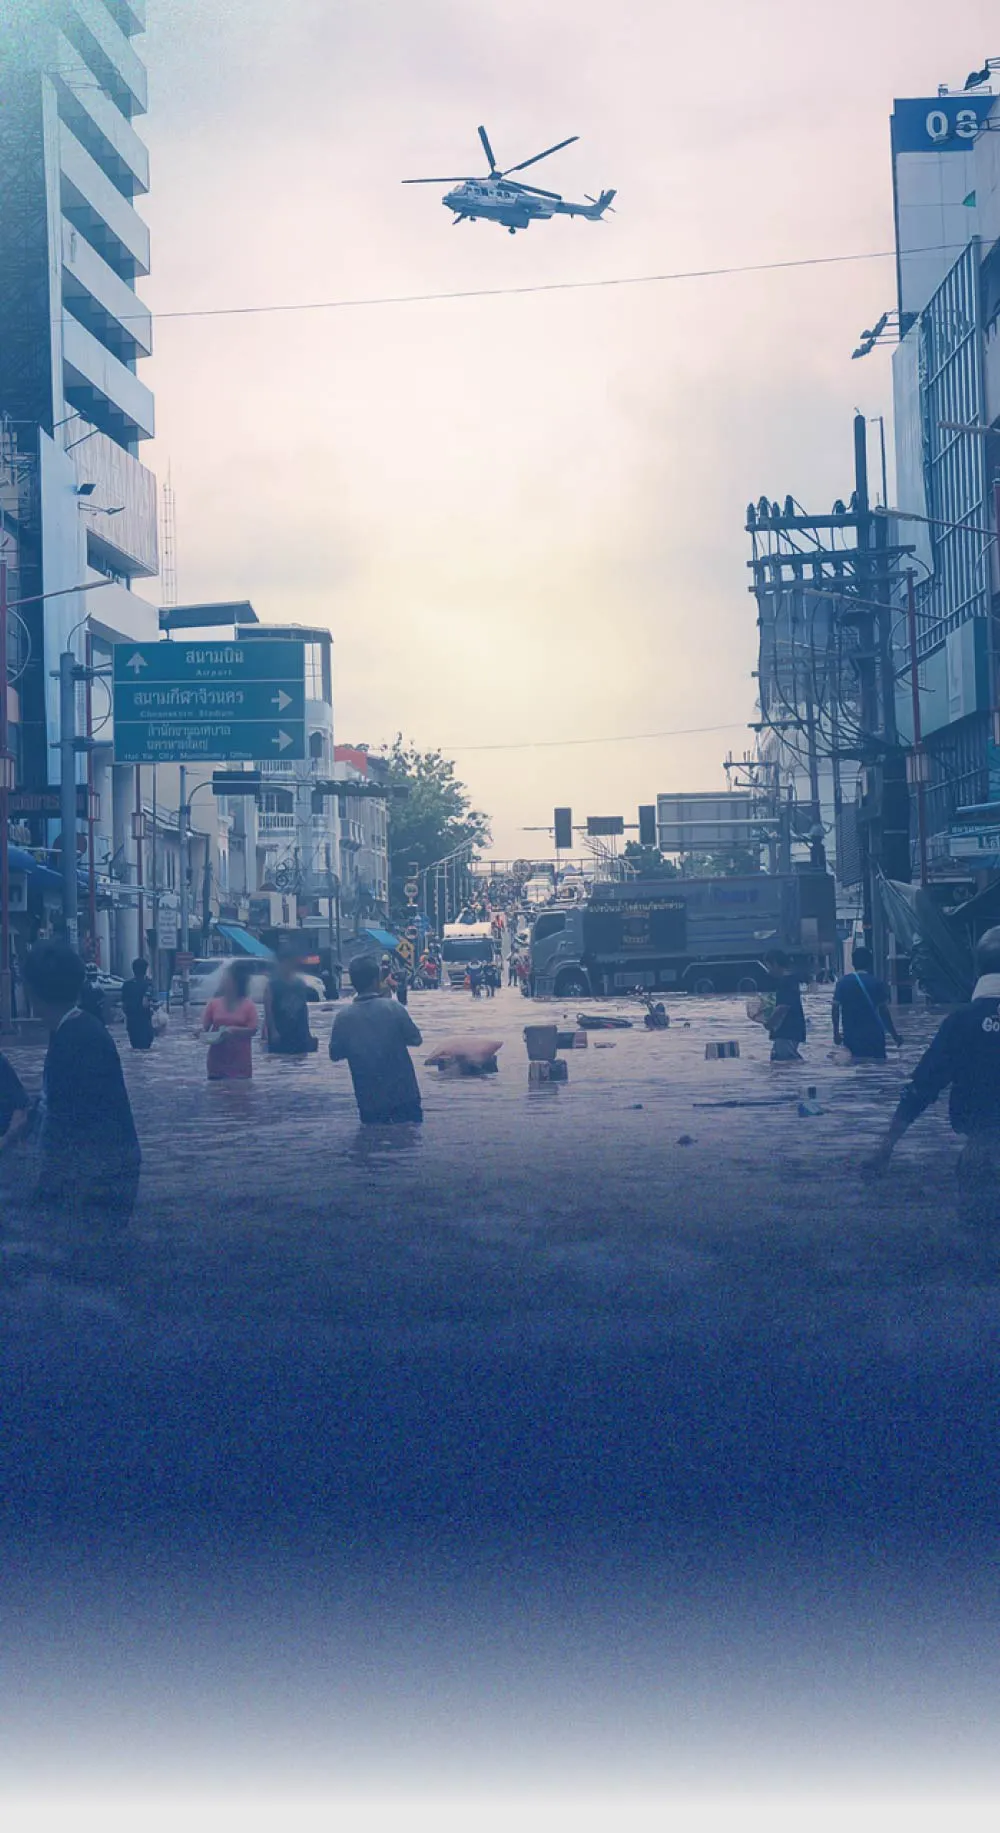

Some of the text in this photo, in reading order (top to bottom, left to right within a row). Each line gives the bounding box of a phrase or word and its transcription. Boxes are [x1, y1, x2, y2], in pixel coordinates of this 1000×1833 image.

[185, 647, 244, 664] สนามบิน
[196, 669, 232, 677] Airport
